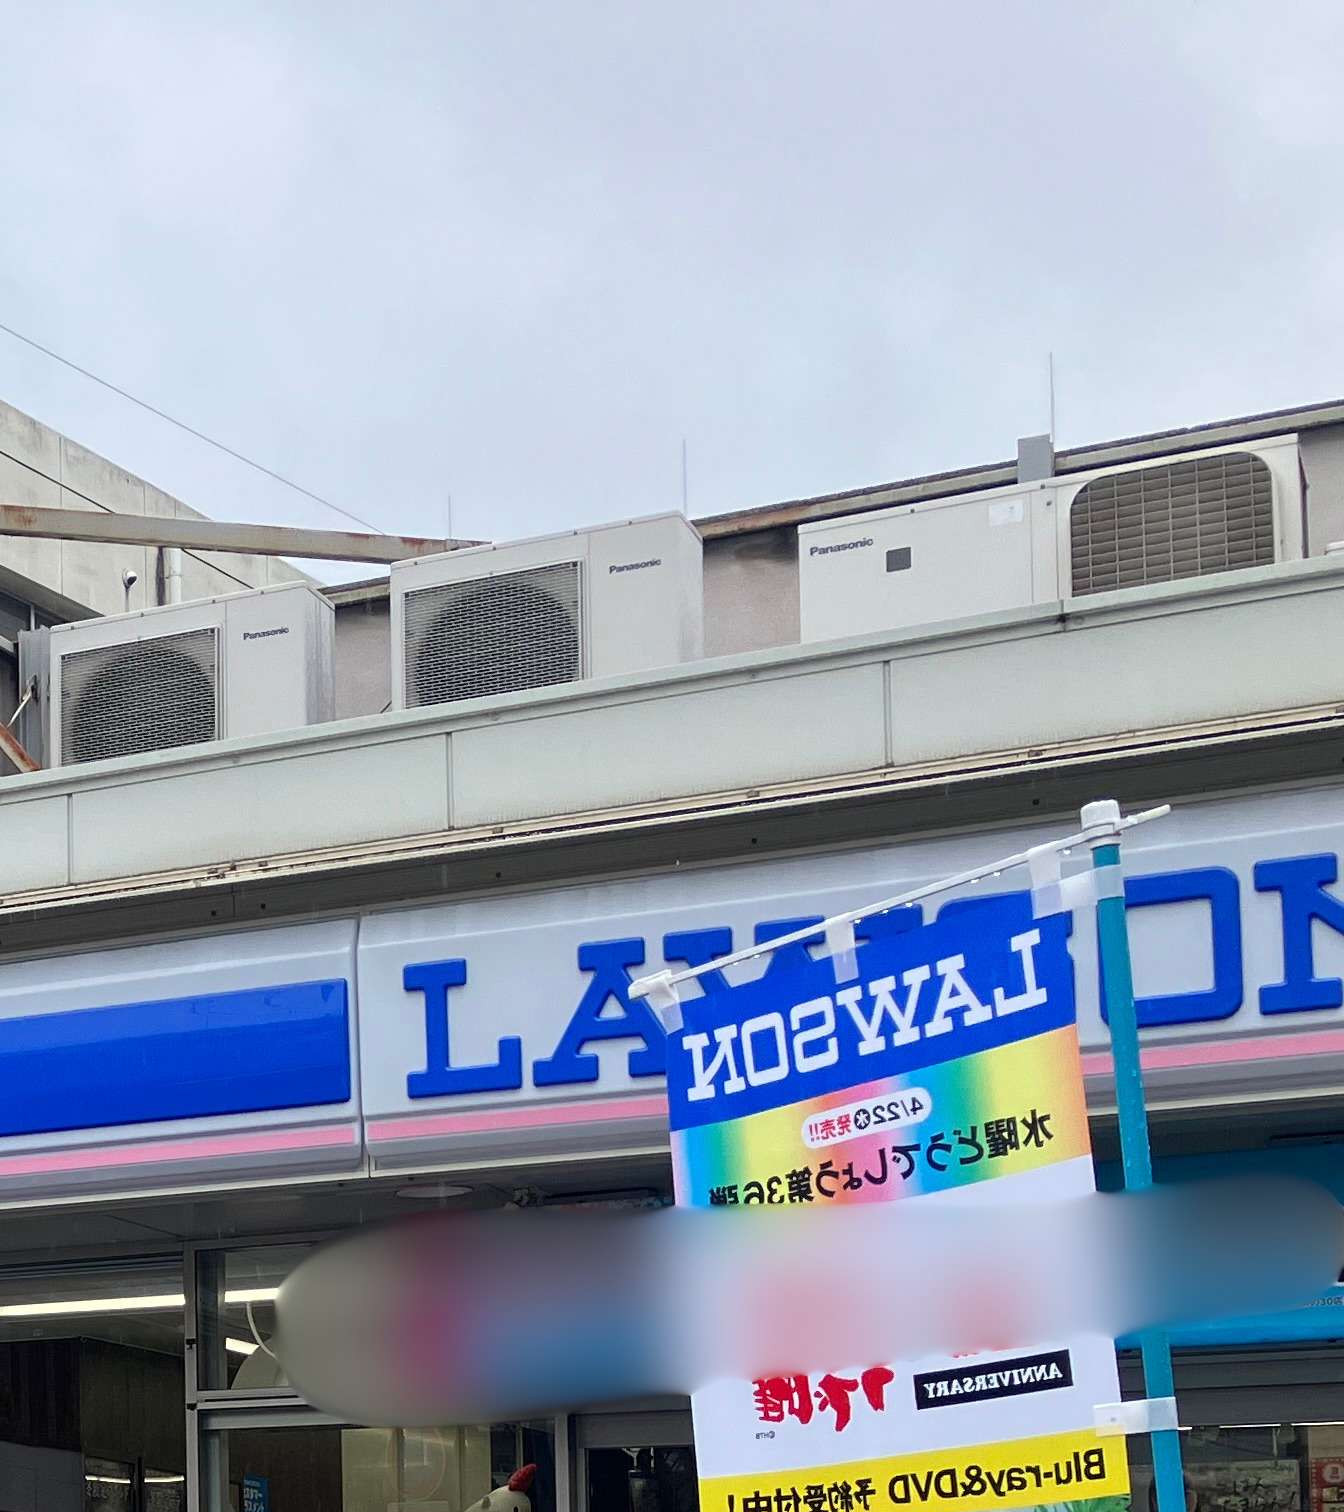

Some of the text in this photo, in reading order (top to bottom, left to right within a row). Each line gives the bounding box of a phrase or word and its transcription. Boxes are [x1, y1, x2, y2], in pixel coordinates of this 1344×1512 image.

[809, 537, 874, 556] Panasonic
[609, 558, 662, 574] Panasonic
[243, 627, 290, 640] Panasonic
[403, 855, 1344, 1100] LAON
